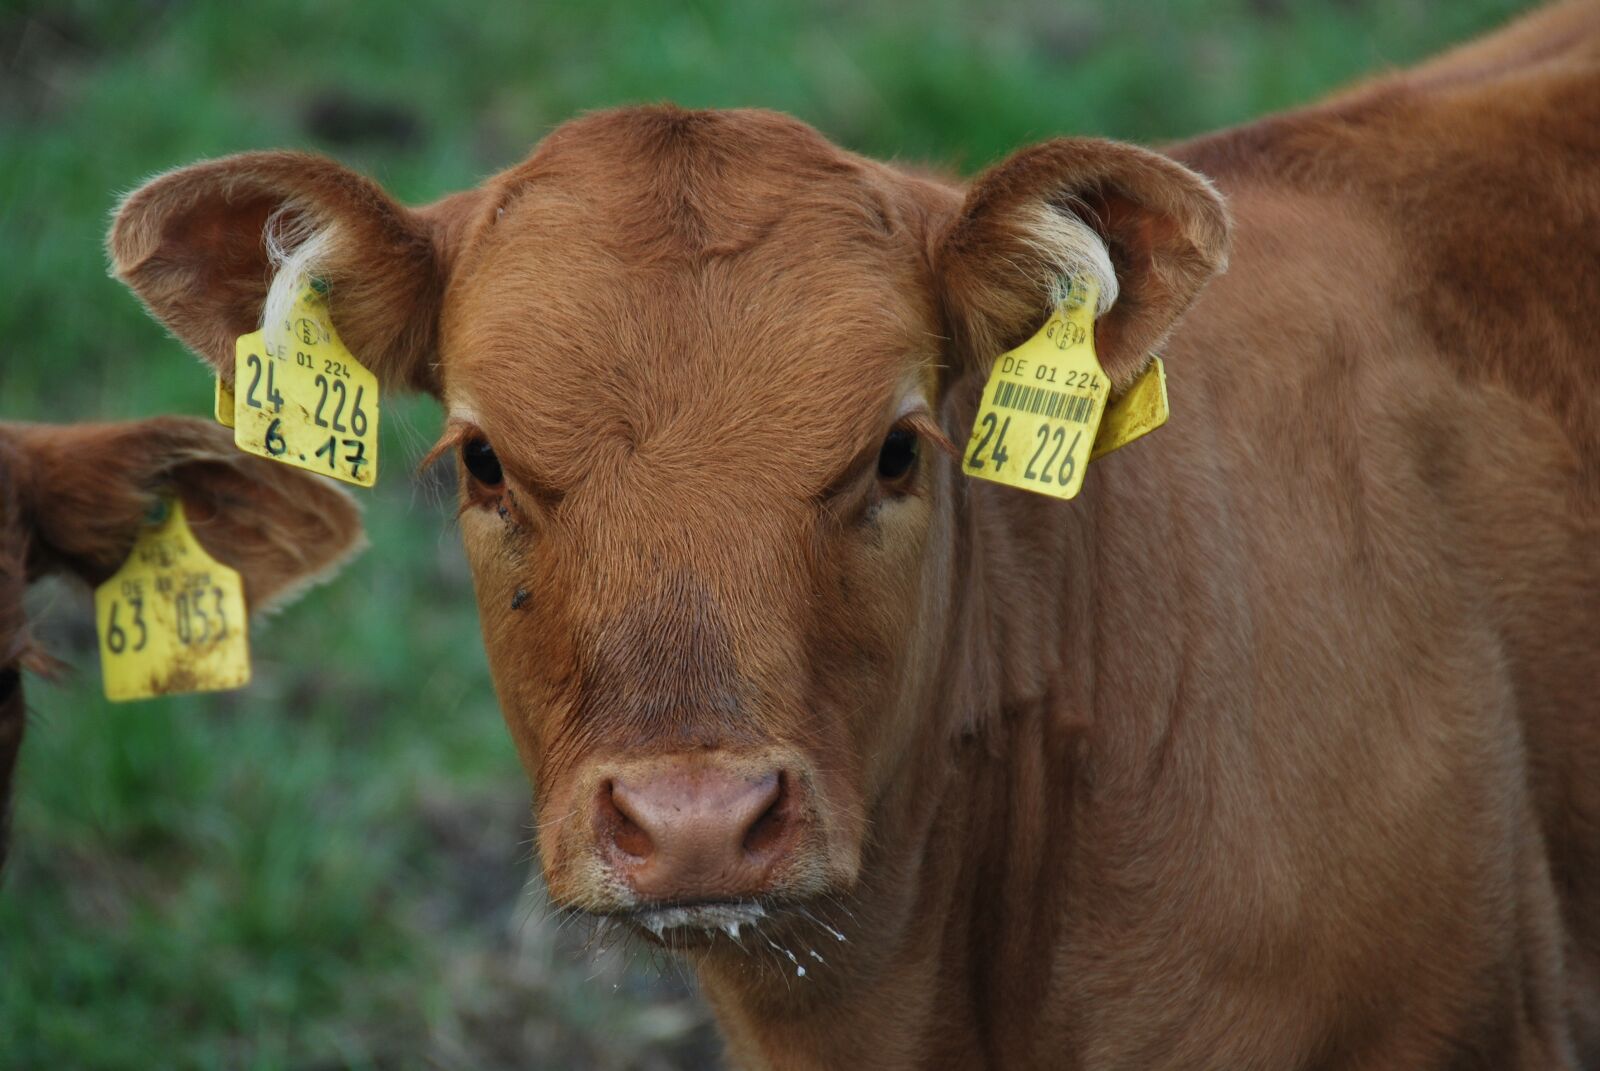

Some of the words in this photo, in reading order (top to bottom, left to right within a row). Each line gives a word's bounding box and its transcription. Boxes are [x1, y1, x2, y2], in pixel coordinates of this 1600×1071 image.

[246, 353, 284, 414] 24
[314, 374, 368, 437] 226
[296, 351, 314, 369] 01
[324, 359, 351, 379] 224
[1002, 356, 1028, 377] DE
[1035, 364, 1057, 383] 01
[1065, 370, 1101, 391] 224
[969, 411, 1012, 472] 24
[1023, 423, 1082, 487] 226
[107, 598, 147, 655] 63
[175, 587, 227, 646] 053
